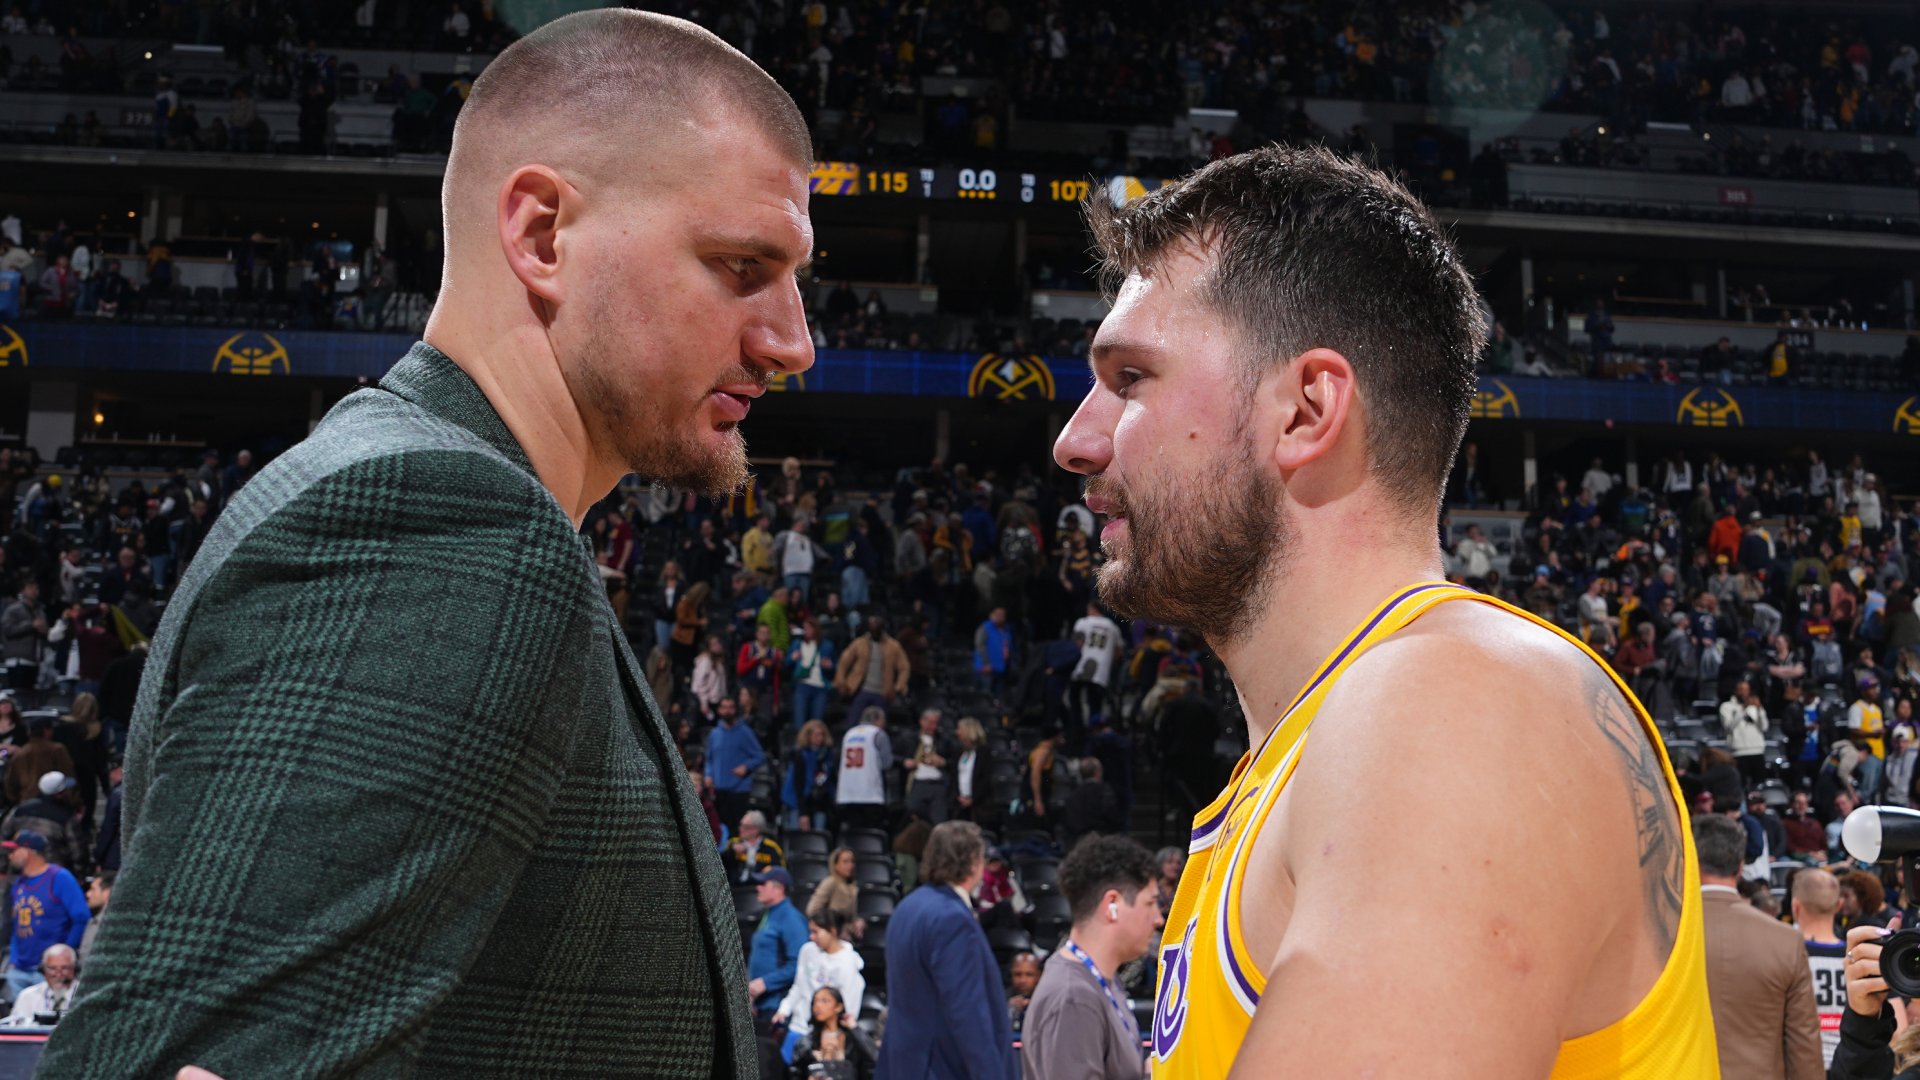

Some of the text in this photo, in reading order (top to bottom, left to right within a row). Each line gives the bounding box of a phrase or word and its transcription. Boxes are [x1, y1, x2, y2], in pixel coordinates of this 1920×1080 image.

[868, 171, 908, 193] 115
[958, 168, 996, 191] 0.0
[1050, 180, 1090, 201] 107
[1020, 187, 1034, 202] 0
[846, 747, 864, 769] 50
